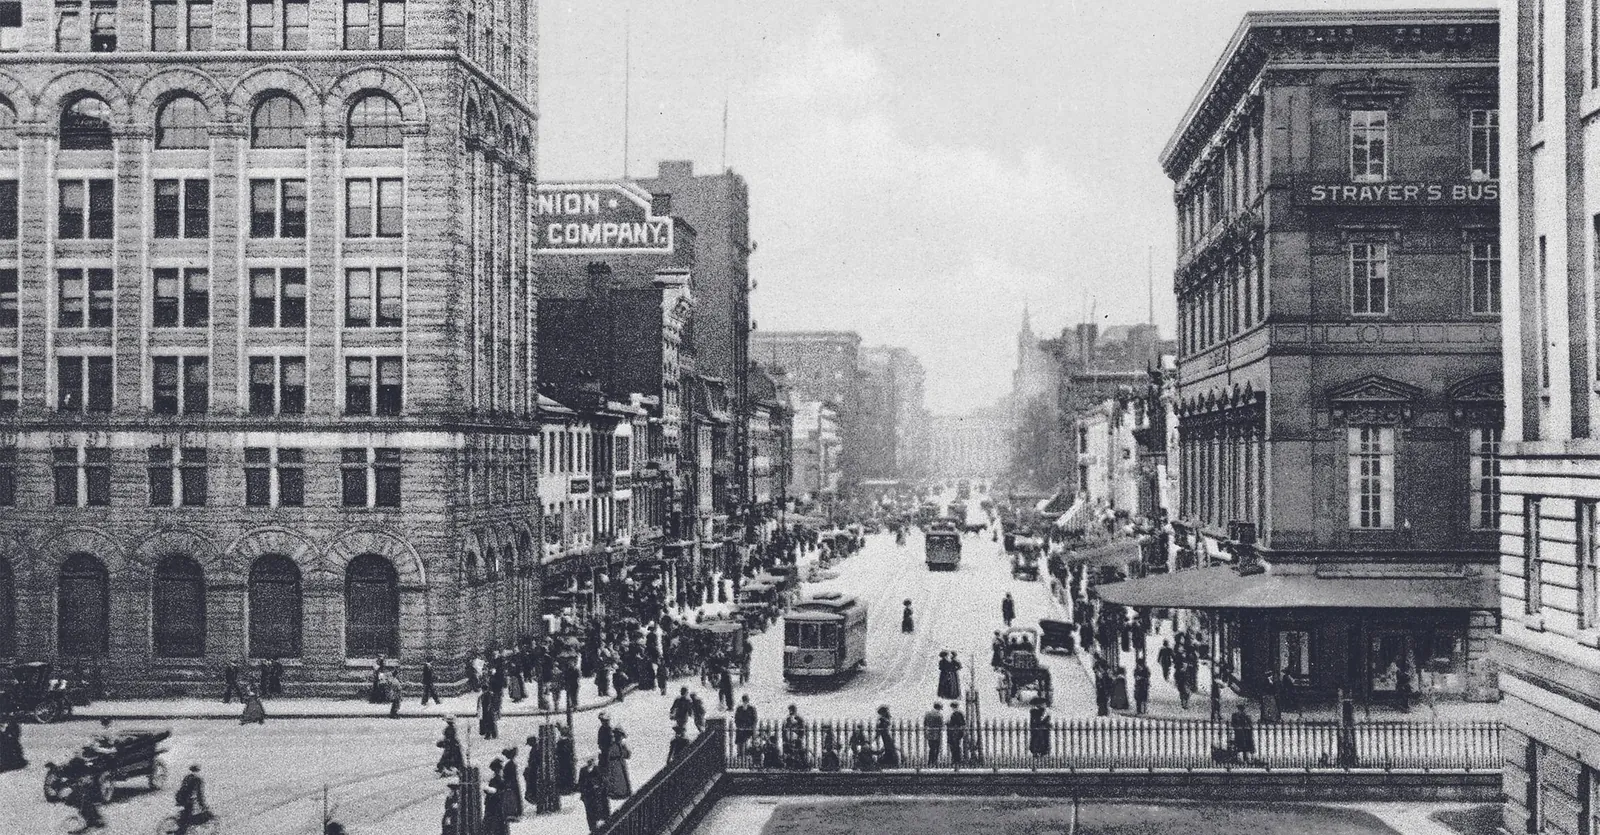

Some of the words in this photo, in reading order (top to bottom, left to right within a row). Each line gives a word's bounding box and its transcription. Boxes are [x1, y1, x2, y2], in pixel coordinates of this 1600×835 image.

[1311, 185, 1442, 201] STRAYER'S
[1452, 185, 1498, 200] BUS
[548, 222, 666, 243] COMPANY.
